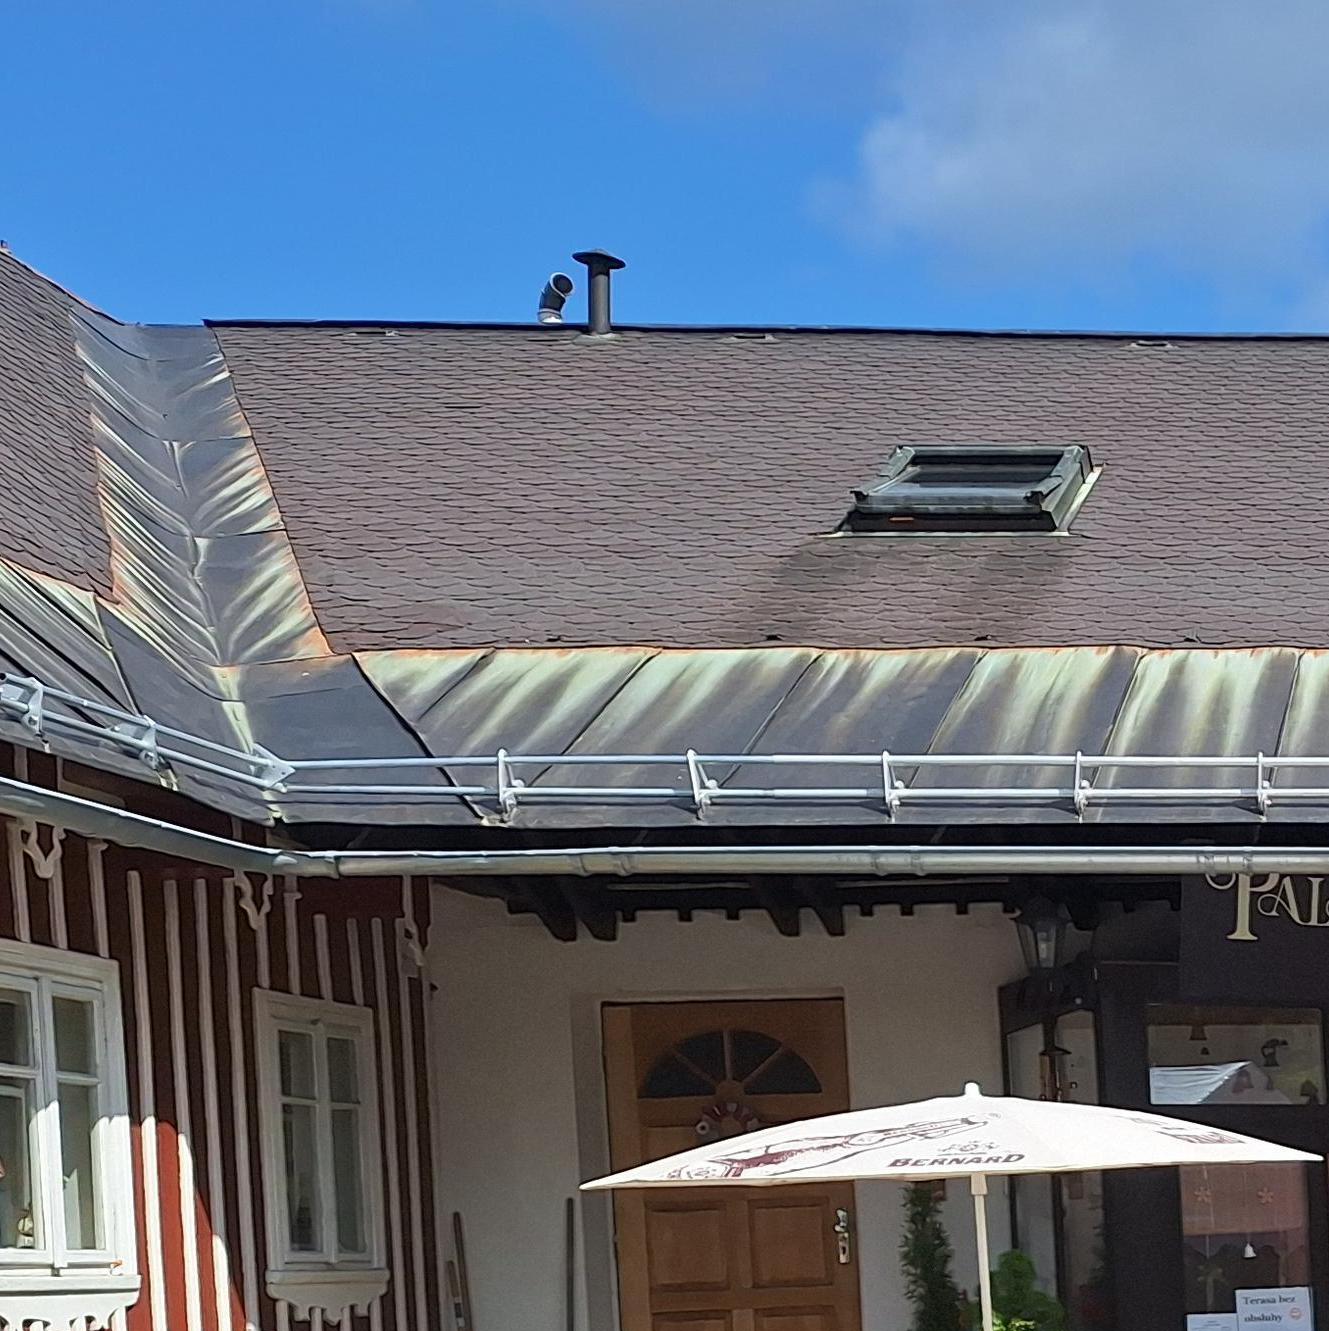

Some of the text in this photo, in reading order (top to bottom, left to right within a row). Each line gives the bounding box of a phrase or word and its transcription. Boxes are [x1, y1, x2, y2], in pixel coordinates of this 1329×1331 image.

[888, 1153, 1026, 1168] BERNARD
[1242, 1295, 1295, 1305] Terasa bez
